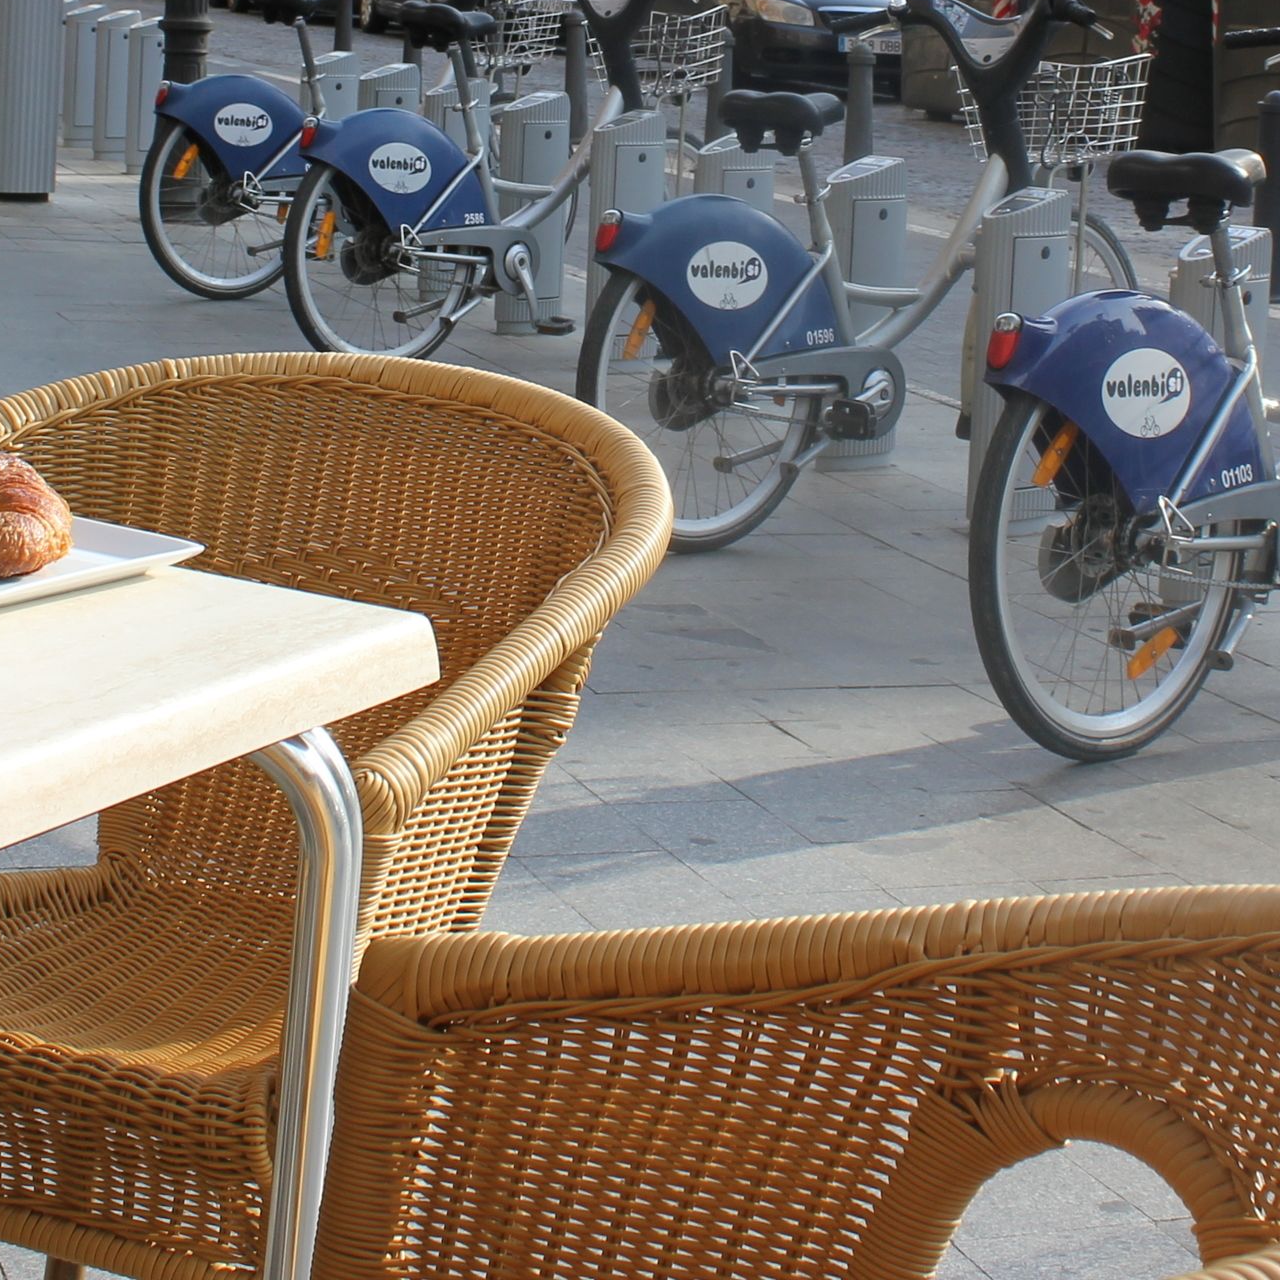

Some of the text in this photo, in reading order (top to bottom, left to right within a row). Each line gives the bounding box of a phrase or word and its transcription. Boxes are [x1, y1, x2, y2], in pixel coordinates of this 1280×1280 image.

[371, 156, 427, 173] valenbisi
[690, 257, 762, 280] valenbisi
[806, 328, 835, 346] 01596
[1106, 367, 1184, 398] valenbisi
[1221, 463, 1253, 489] 01103
